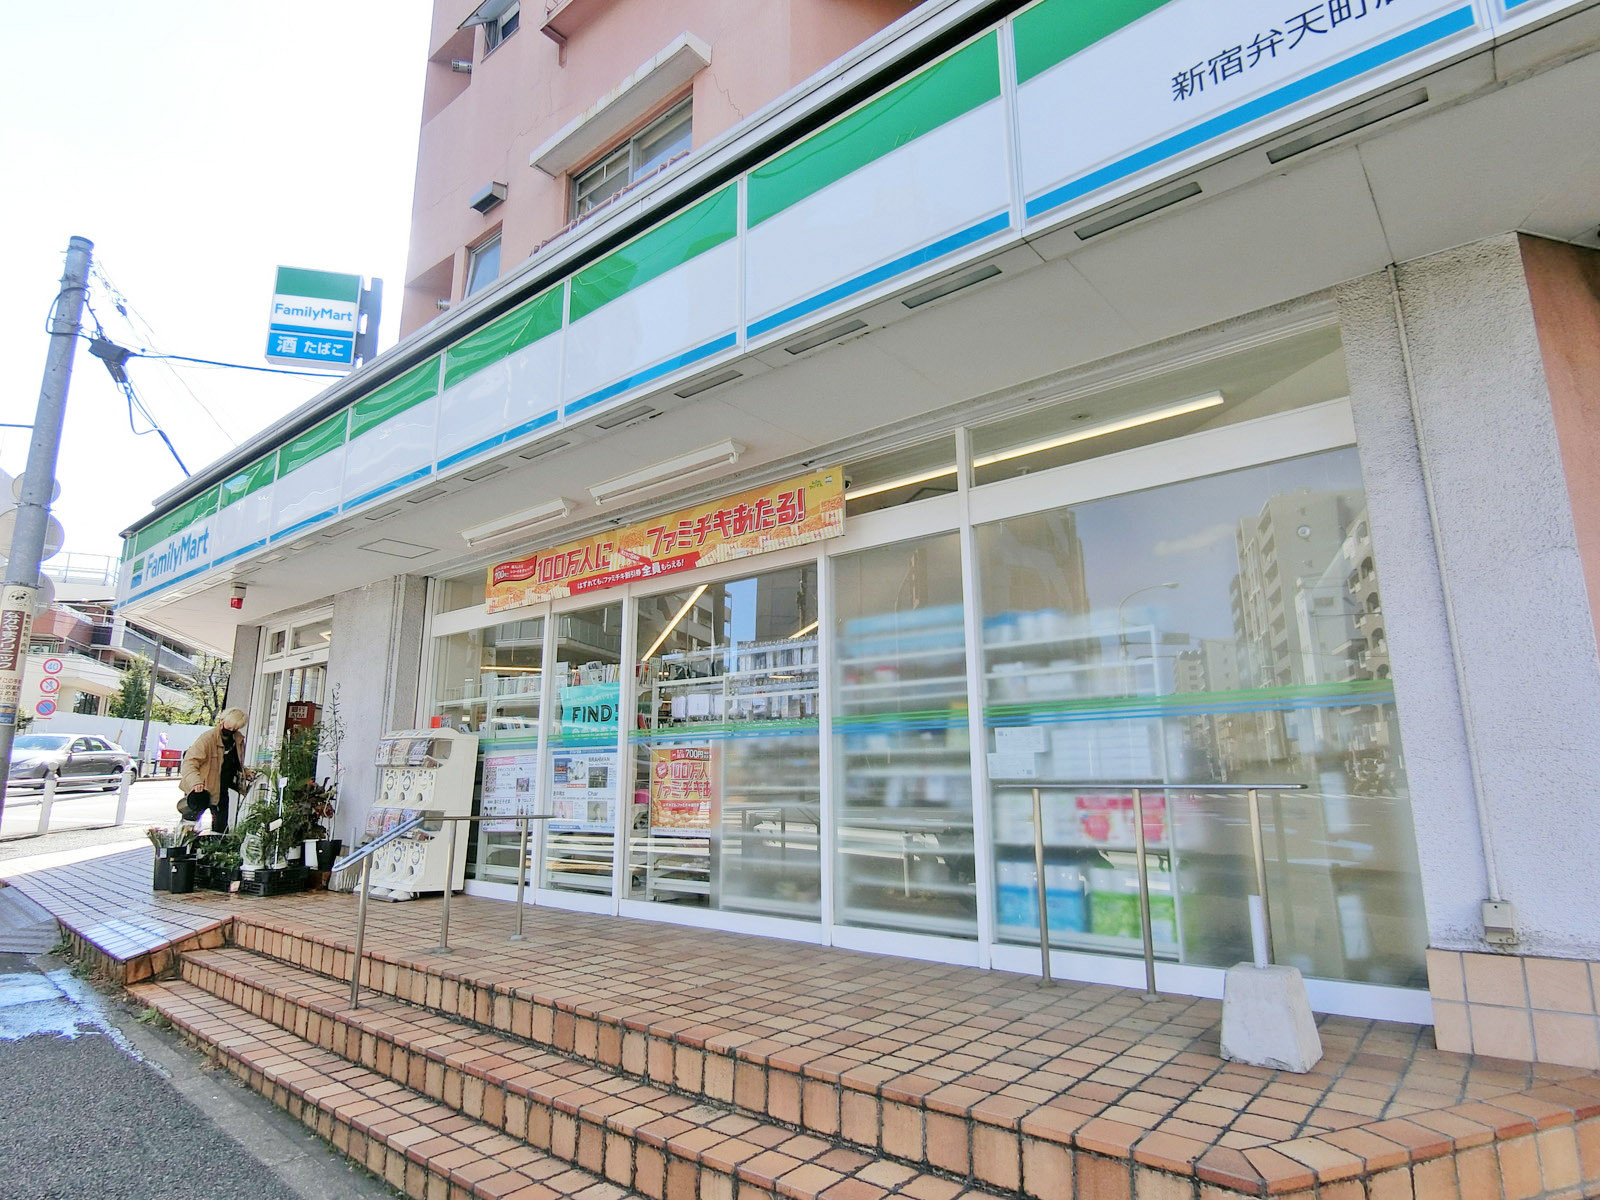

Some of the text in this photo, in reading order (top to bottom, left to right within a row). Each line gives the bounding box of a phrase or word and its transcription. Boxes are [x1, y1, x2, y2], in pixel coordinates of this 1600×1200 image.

[1171, 0, 1394, 101] 新宿弁天町
[274, 303, 353, 321] FamilyMart
[276, 336, 344, 357] 酒 たばこ
[145, 526, 209, 581] FamilyMart
[537, 542, 614, 585] 100万人に
[47, 663, 59, 671] 40
